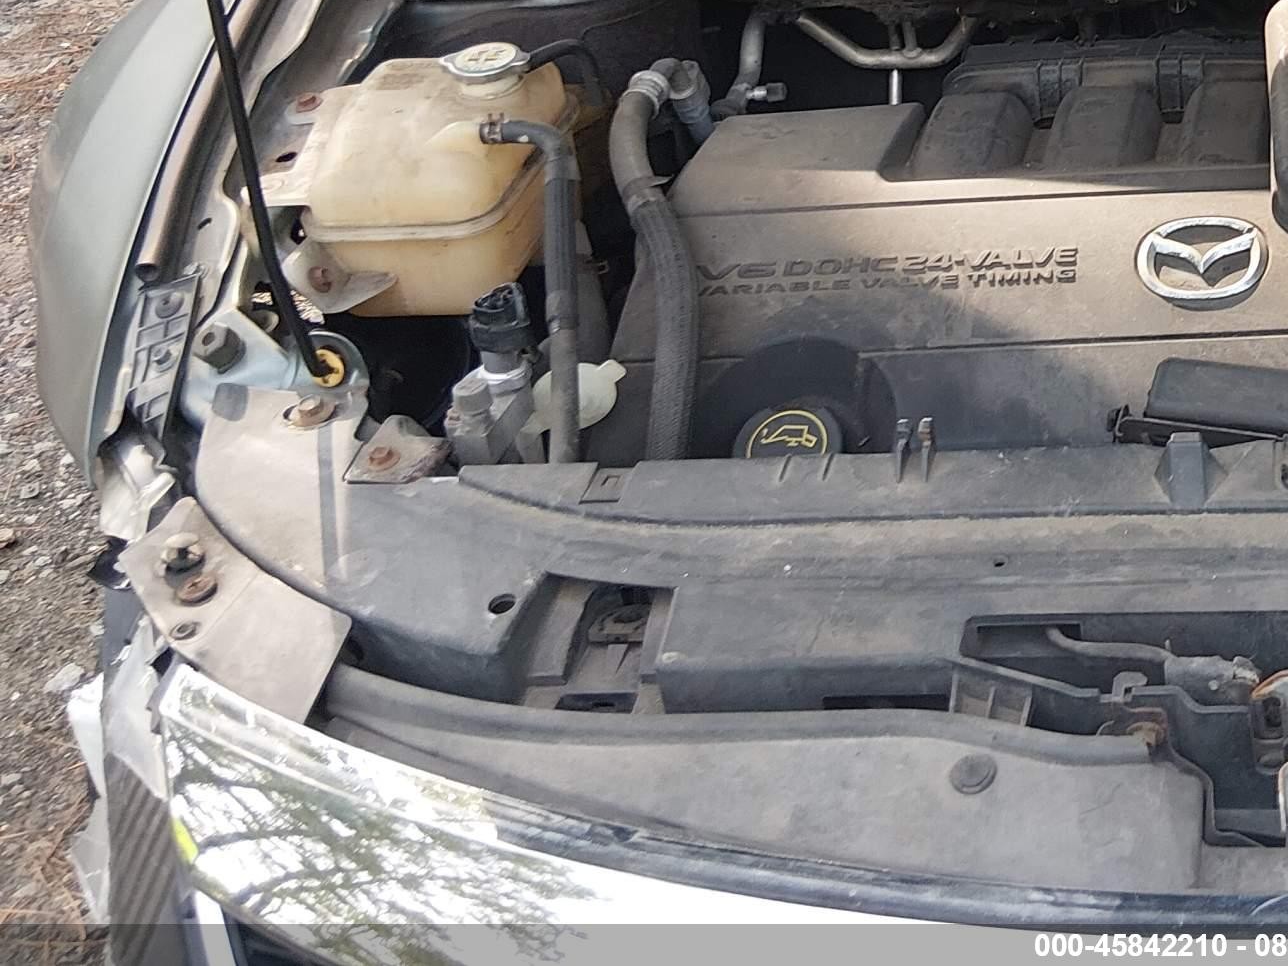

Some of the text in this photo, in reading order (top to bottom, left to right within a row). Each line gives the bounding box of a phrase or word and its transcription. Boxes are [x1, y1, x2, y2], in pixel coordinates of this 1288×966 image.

[697, 247, 1079, 281] V6 DOHC 24-VALVE
[861, 272, 960, 290] VALVE
[967, 268, 1078, 288] TIMING
